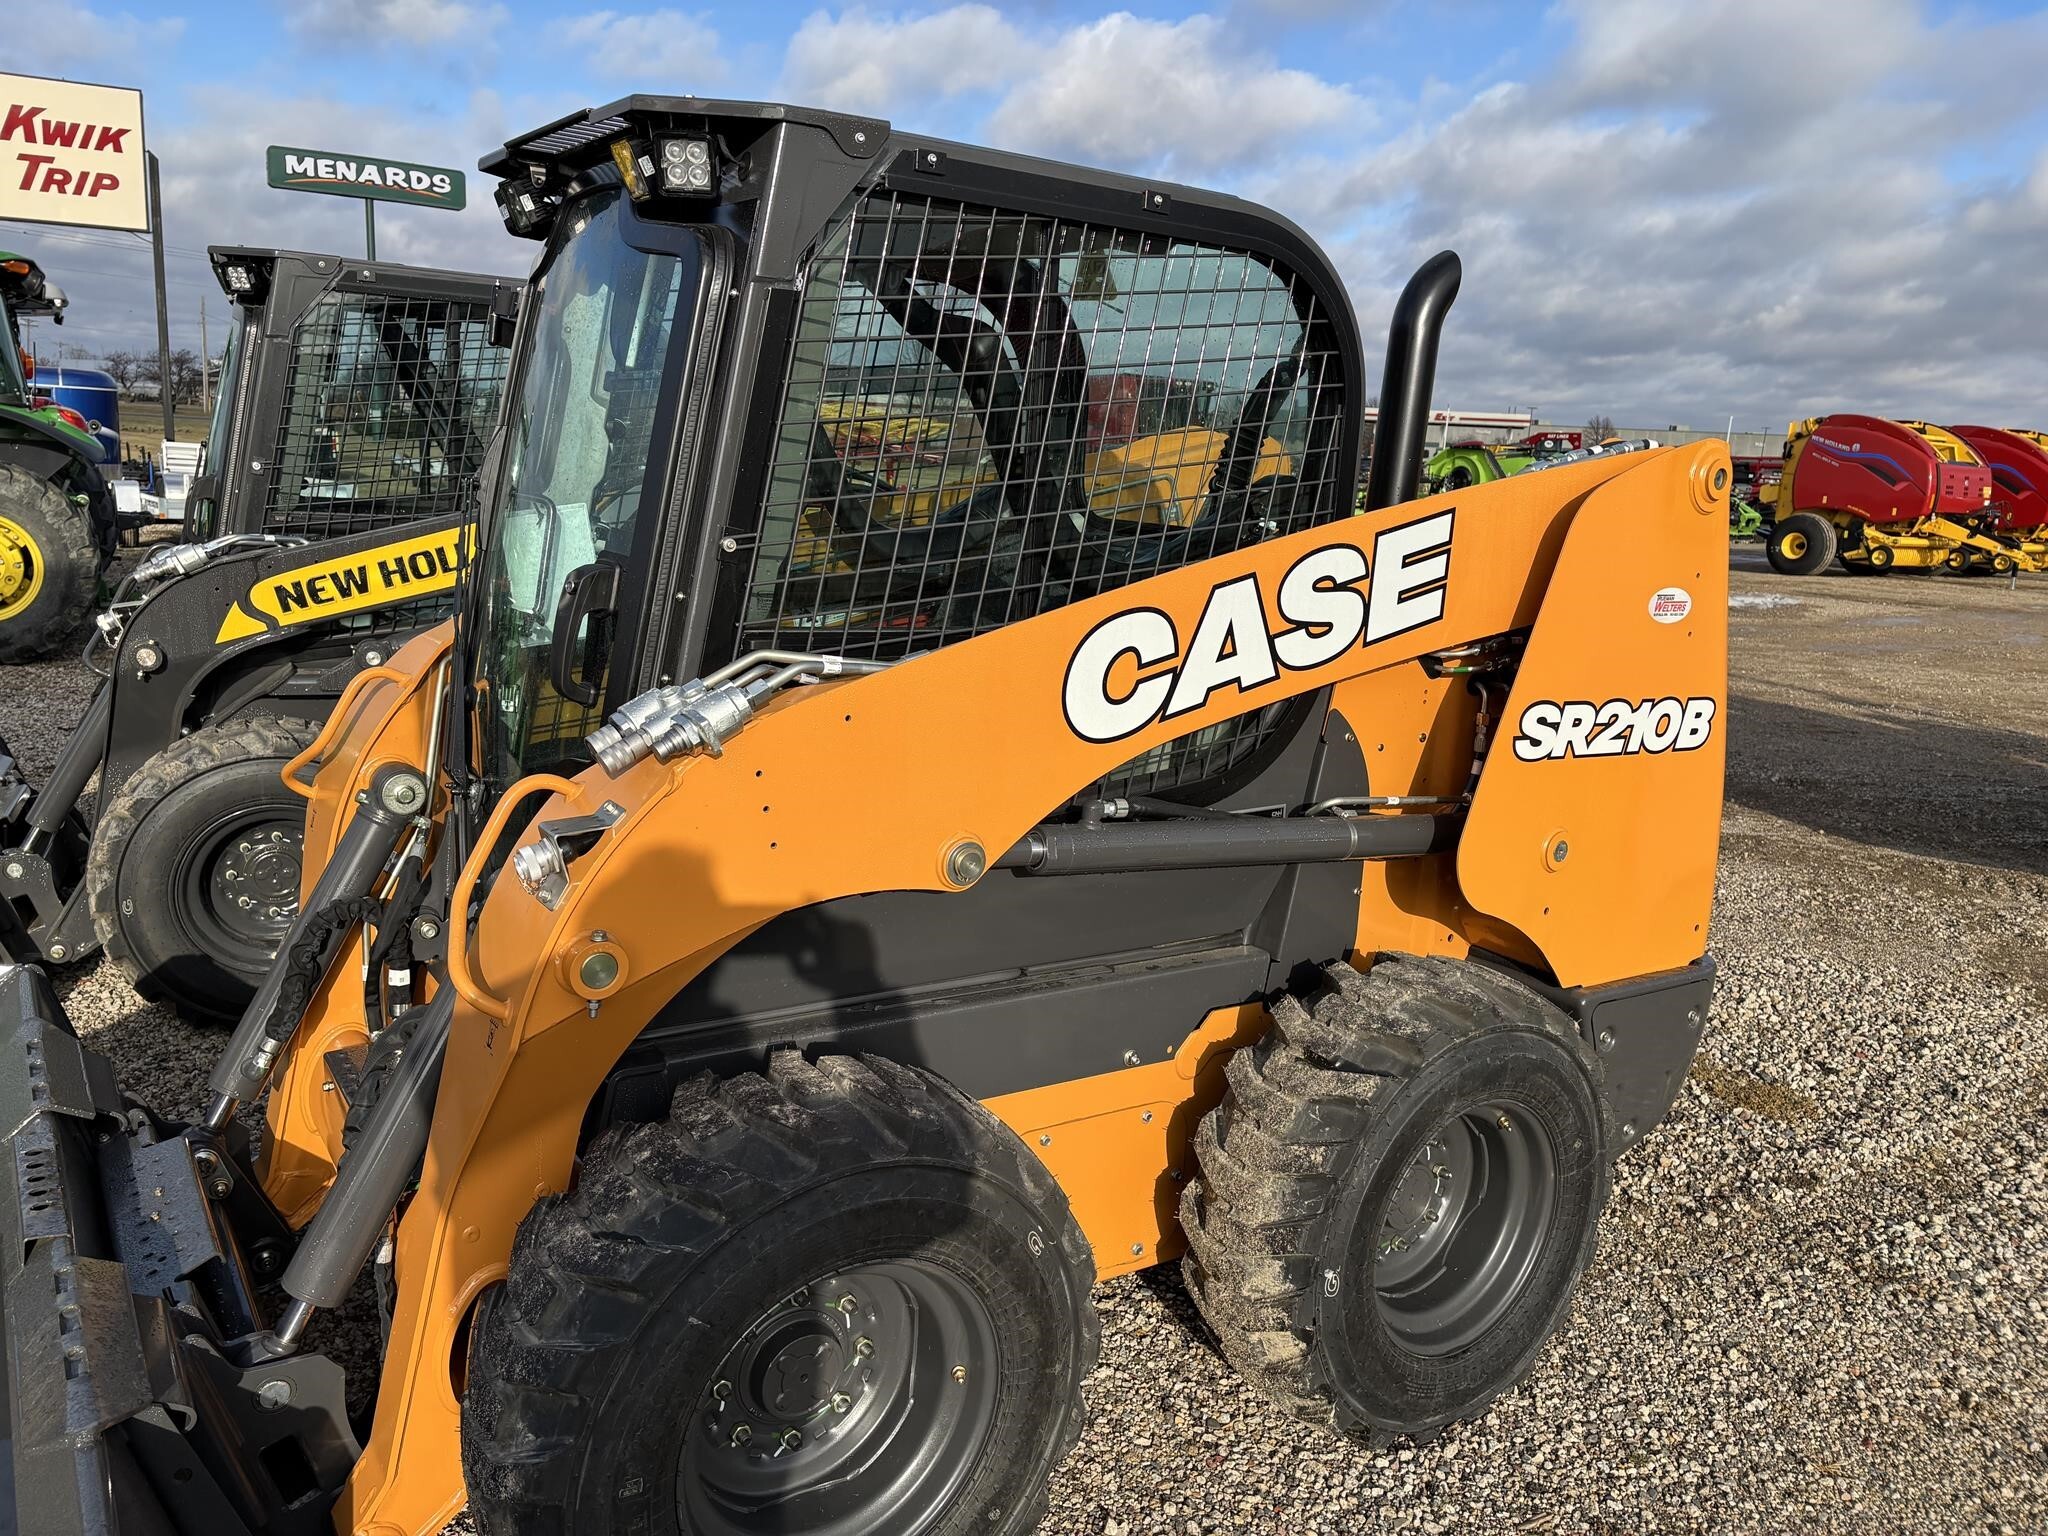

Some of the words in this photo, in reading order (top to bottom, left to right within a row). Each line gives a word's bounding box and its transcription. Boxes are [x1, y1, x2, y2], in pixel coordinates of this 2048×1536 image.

[0, 104, 132, 153] KWIK
[16, 153, 120, 197] TRIP
[284, 154, 452, 194] MENARDS
[273, 565, 369, 614] NEW
[377, 543, 460, 589] HOL
[1062, 507, 1456, 744] CASE
[1654, 601, 1688, 612] WELTERS
[1513, 696, 1716, 763] SR210B
